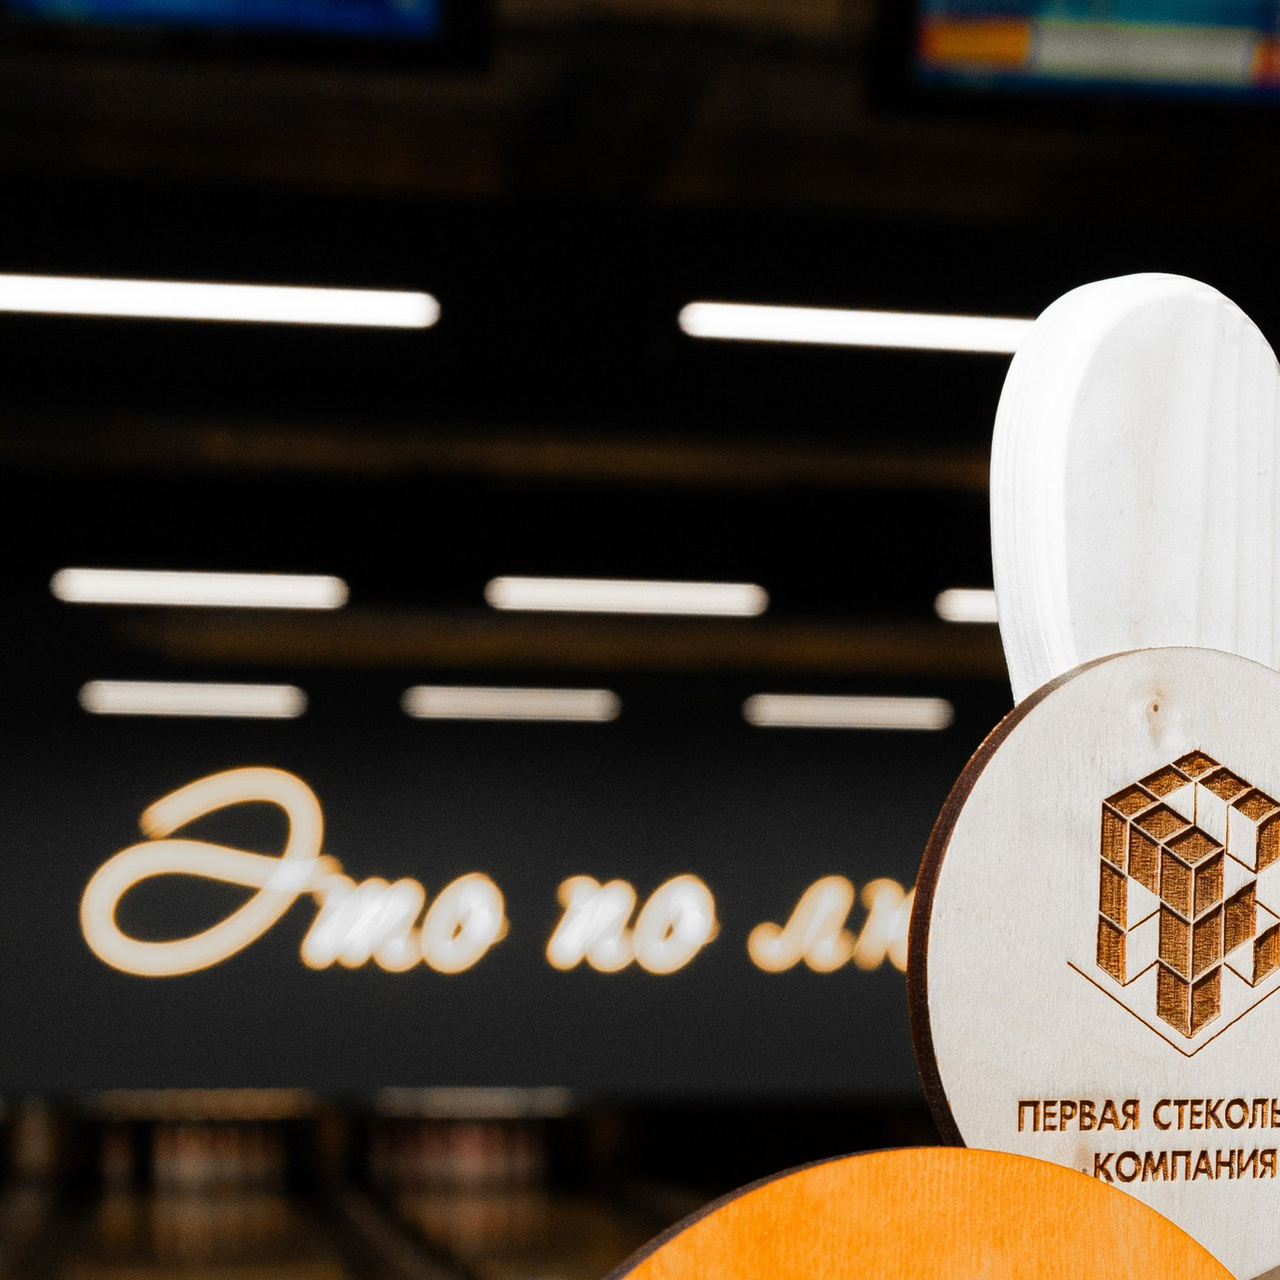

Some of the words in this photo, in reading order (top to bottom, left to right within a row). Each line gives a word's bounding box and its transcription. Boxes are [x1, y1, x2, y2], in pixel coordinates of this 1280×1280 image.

[80, 766, 509, 977] Это
[547, 873, 720, 975] по
[1017, 1099, 1141, 1132] ПЕРВАЯ
[1092, 1149, 1279, 1183] КОМПАНИЯ
